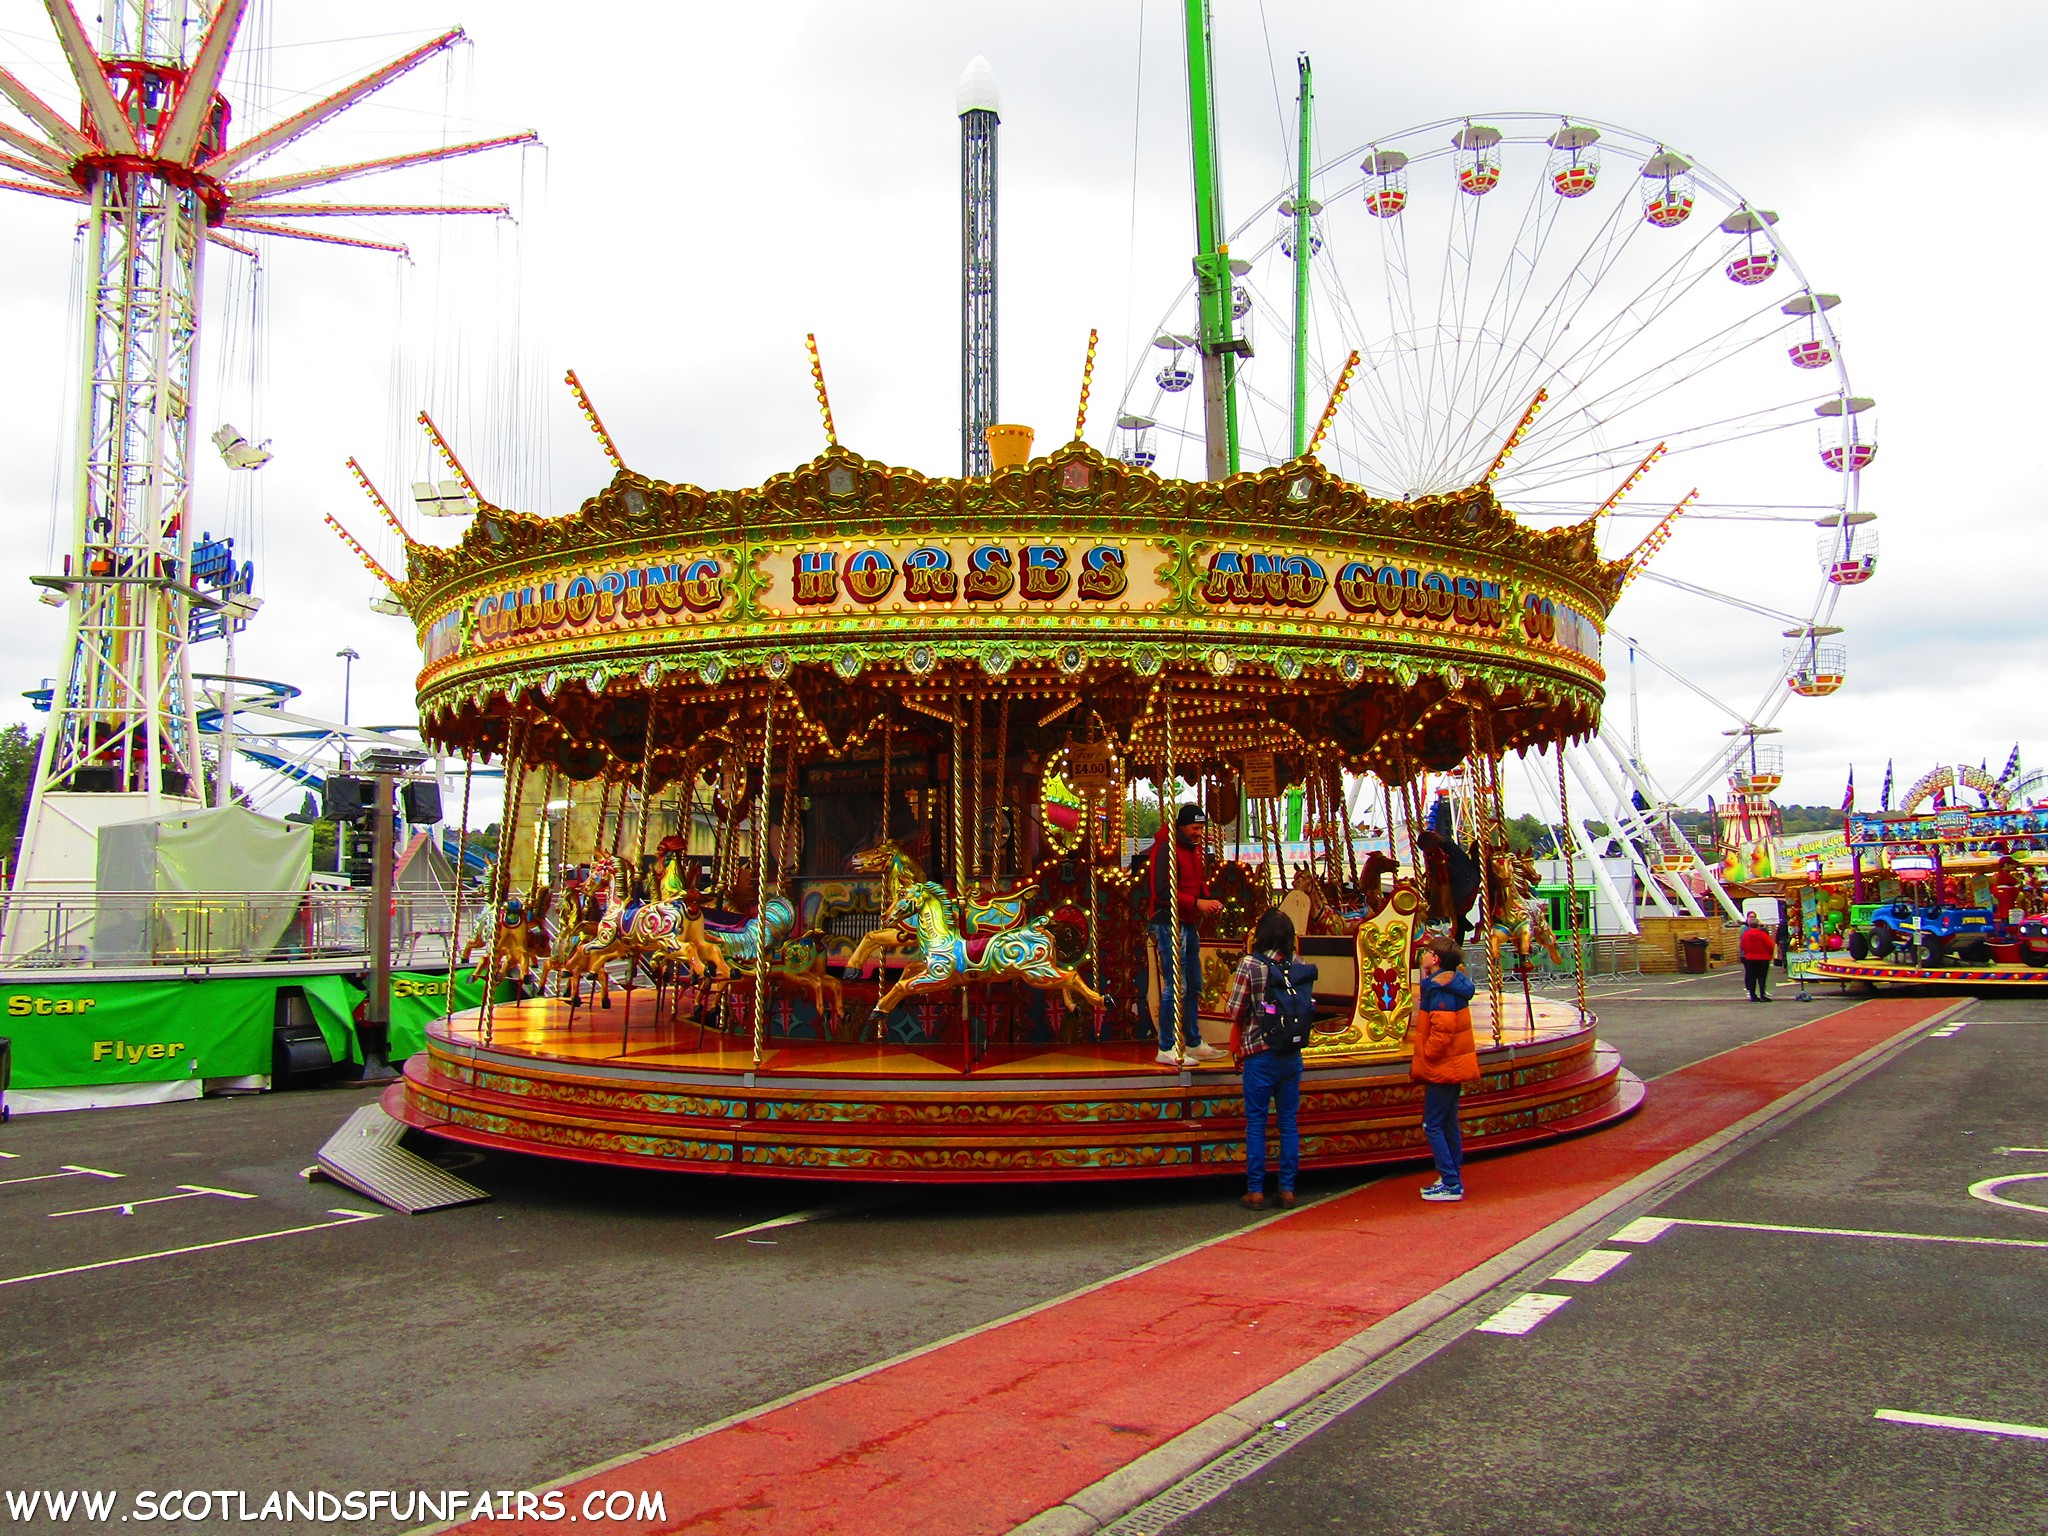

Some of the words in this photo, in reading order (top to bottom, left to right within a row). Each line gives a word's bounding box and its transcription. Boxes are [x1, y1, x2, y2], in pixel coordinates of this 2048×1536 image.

[478, 559, 723, 642] GALLOPING
[792, 545, 1128, 605] HORSES
[1202, 551, 1329, 606] AND
[1334, 560, 1501, 629] GOLDEN
[1075, 763, 1104, 774] £4.00
[1936, 813, 1968, 826] MONSTER
[1781, 848, 1797, 859] TRY
[1797, 840, 1822, 854] YOUR
[8, 993, 96, 1016] Star
[92, 1040, 185, 1065] Flyer
